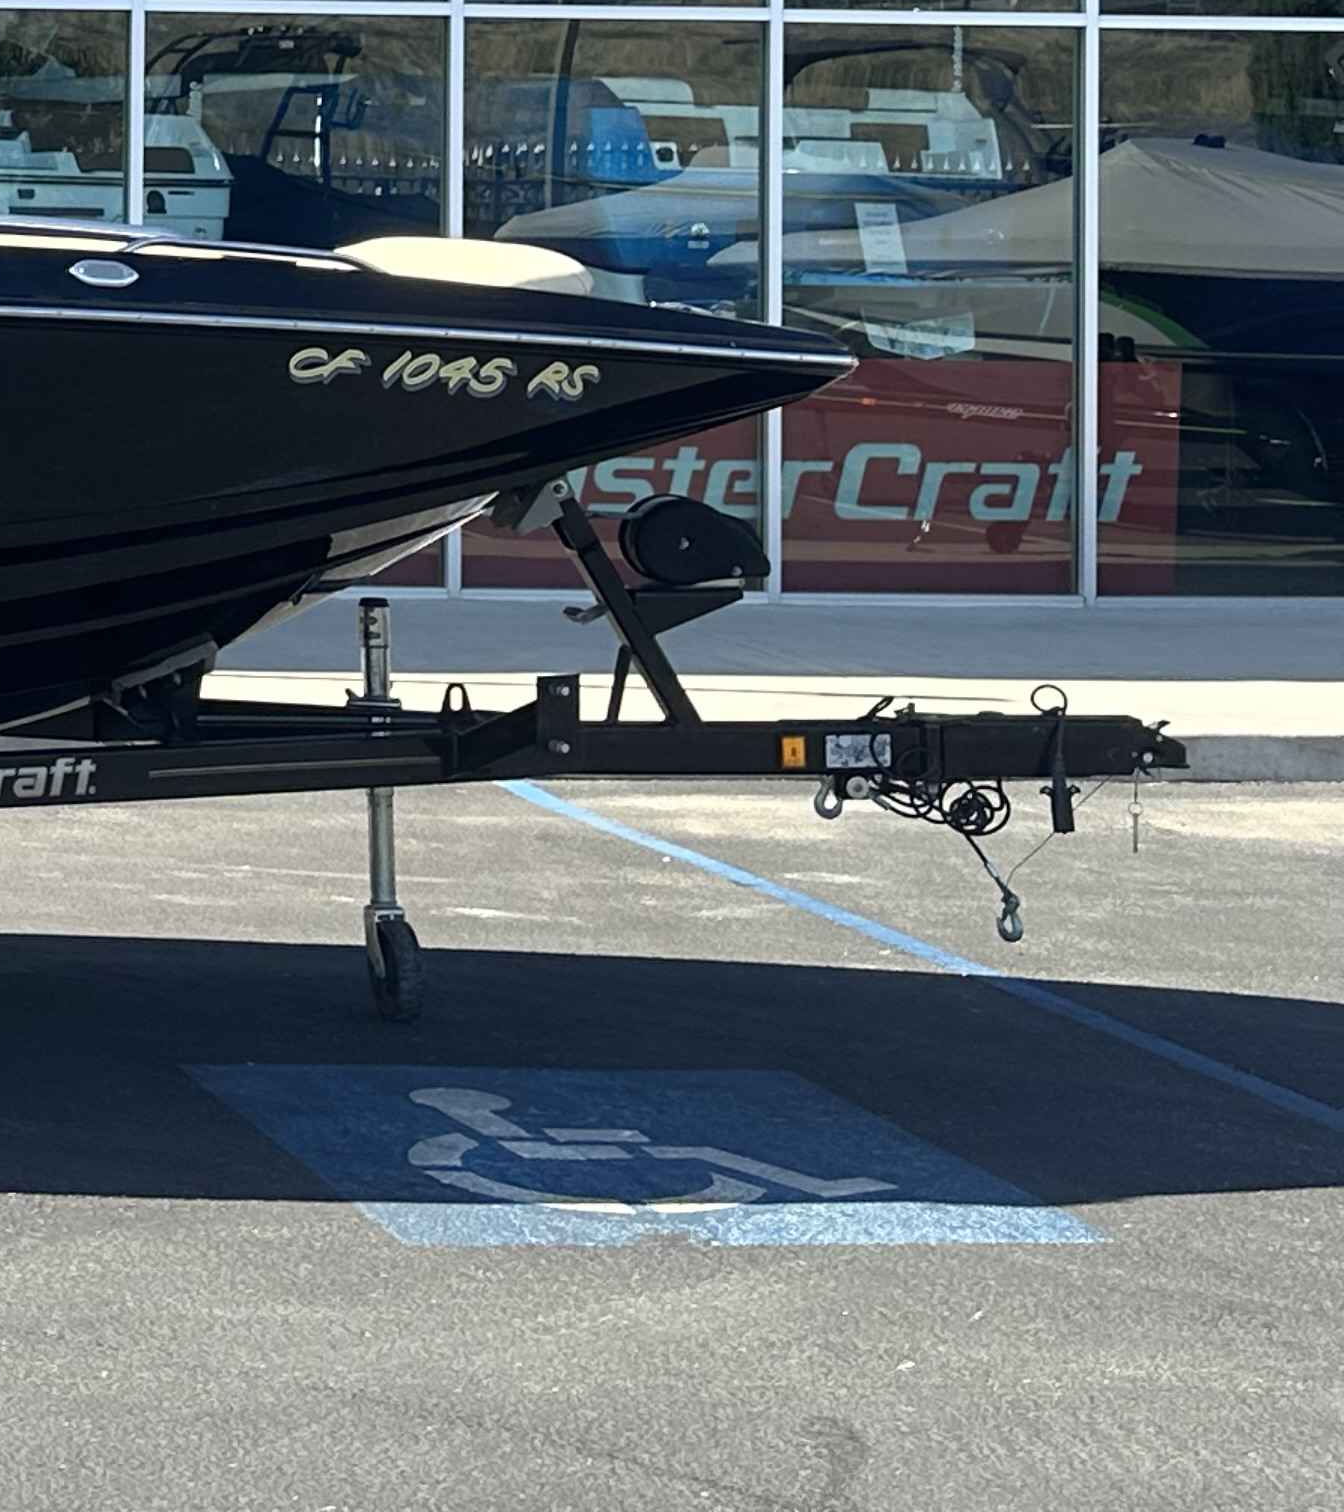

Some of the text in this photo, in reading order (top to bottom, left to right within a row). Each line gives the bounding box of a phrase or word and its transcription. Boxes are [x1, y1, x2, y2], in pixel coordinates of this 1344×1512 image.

[288, 346, 601, 402] CF 1045 RS
[572, 442, 1144, 522] sterCraft
